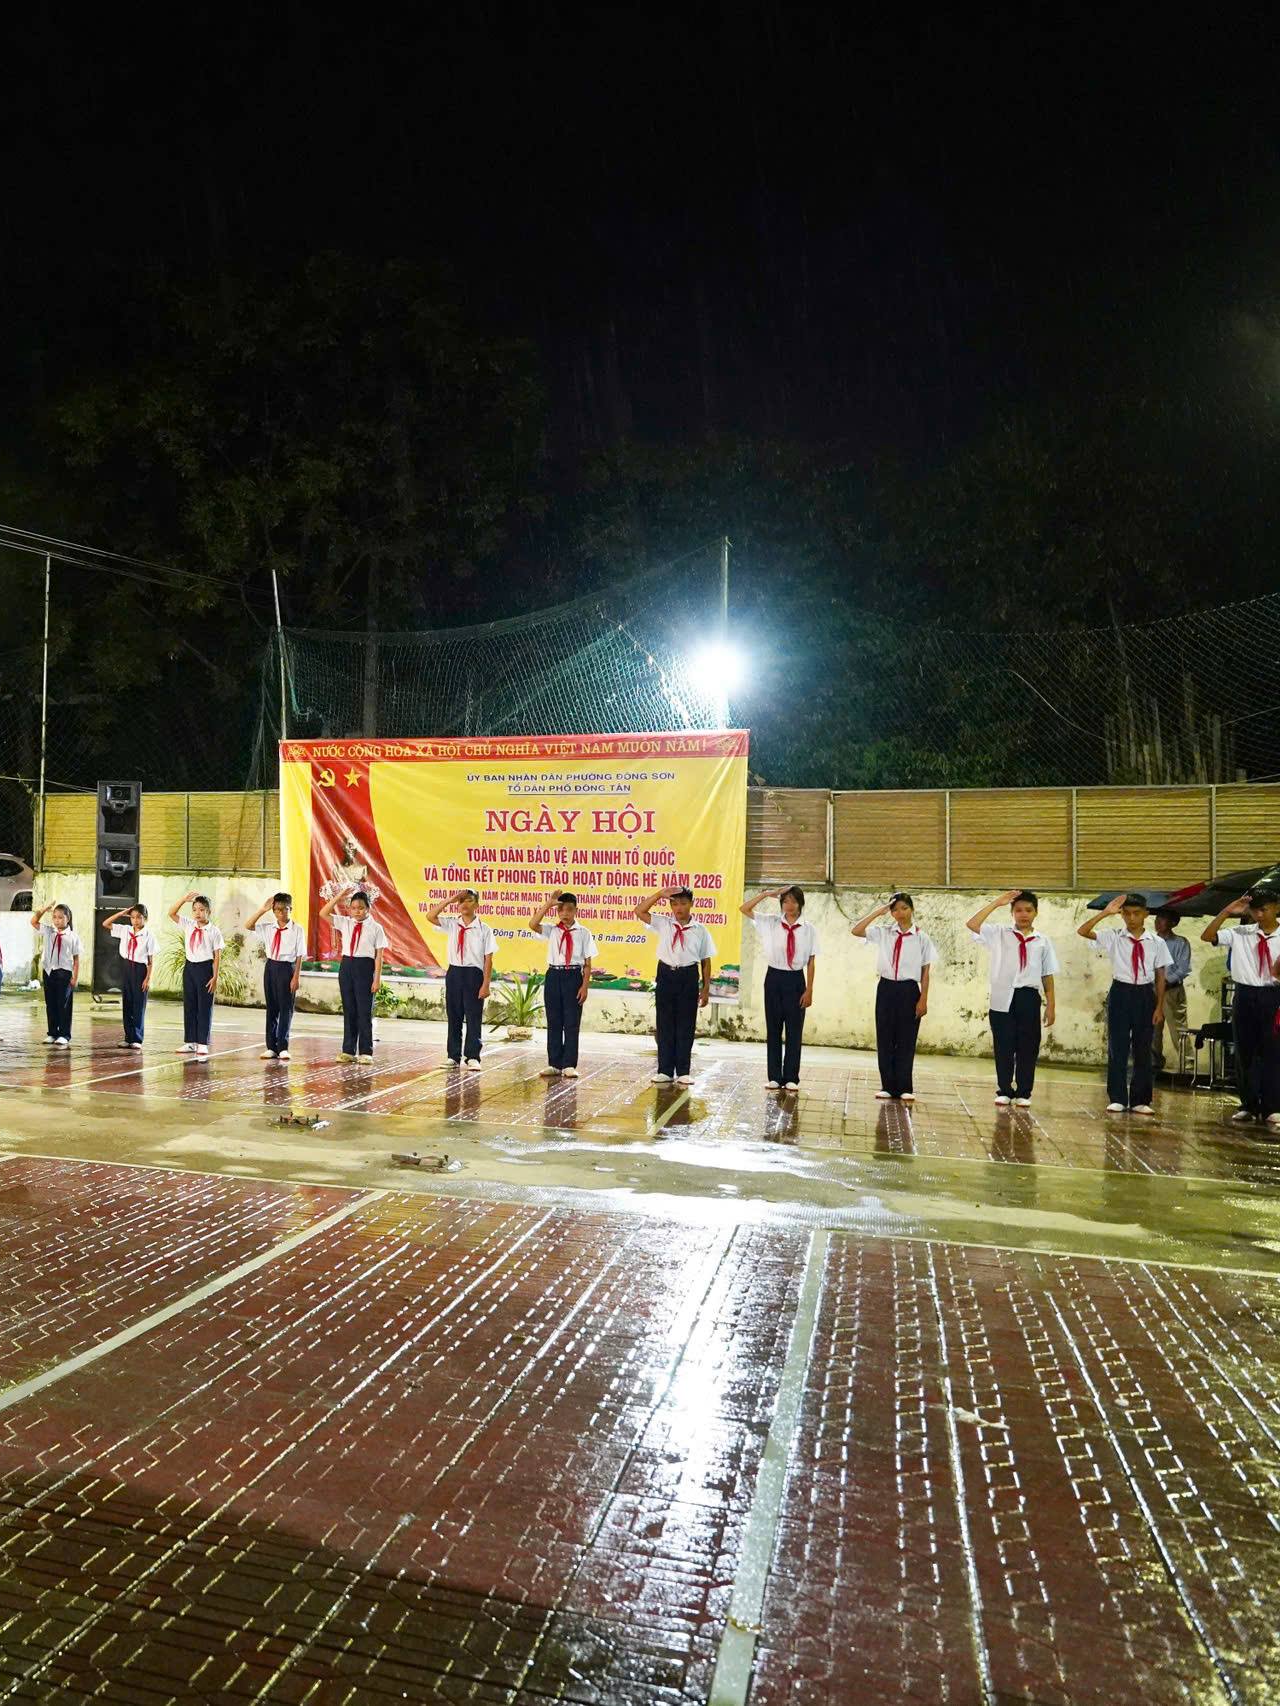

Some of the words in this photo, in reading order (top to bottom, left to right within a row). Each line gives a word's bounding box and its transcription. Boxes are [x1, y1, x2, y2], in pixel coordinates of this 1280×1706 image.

[313, 743, 345, 757] NƯỚC
[348, 742, 382, 759] CỘNG
[438, 742, 461, 758] HỘI
[465, 740, 491, 757] CHỦ
[544, 740, 577, 757] VIỆT
[580, 742, 614, 754] NAM
[485, 803, 581, 833] NGÀY
[592, 803, 656, 839] HỘI
[467, 846, 497, 862] TOÀN
[500, 847, 524, 863] DÂN
[527, 845, 550, 864] BẢO
[554, 847, 568, 867] VỆ
[571, 850, 588, 865] AN
[592, 850, 621, 865] NINH
[625, 845, 640, 865] TỔ
[643, 846, 675, 867] QUỐC
[424, 865, 438, 881] VÀ
[442, 863, 470, 882] TỔNG
[474, 865, 494, 883] KẾT
[497, 870, 536, 884] PHONG
[540, 867, 569, 885] TRÀO
[572, 871, 603, 889] HOẠT
[606, 869, 639, 889] ĐỘNG
[642, 870, 657, 887] HÈ
[661, 870, 690, 888] NĂM
[694, 874, 722, 889] 2026
